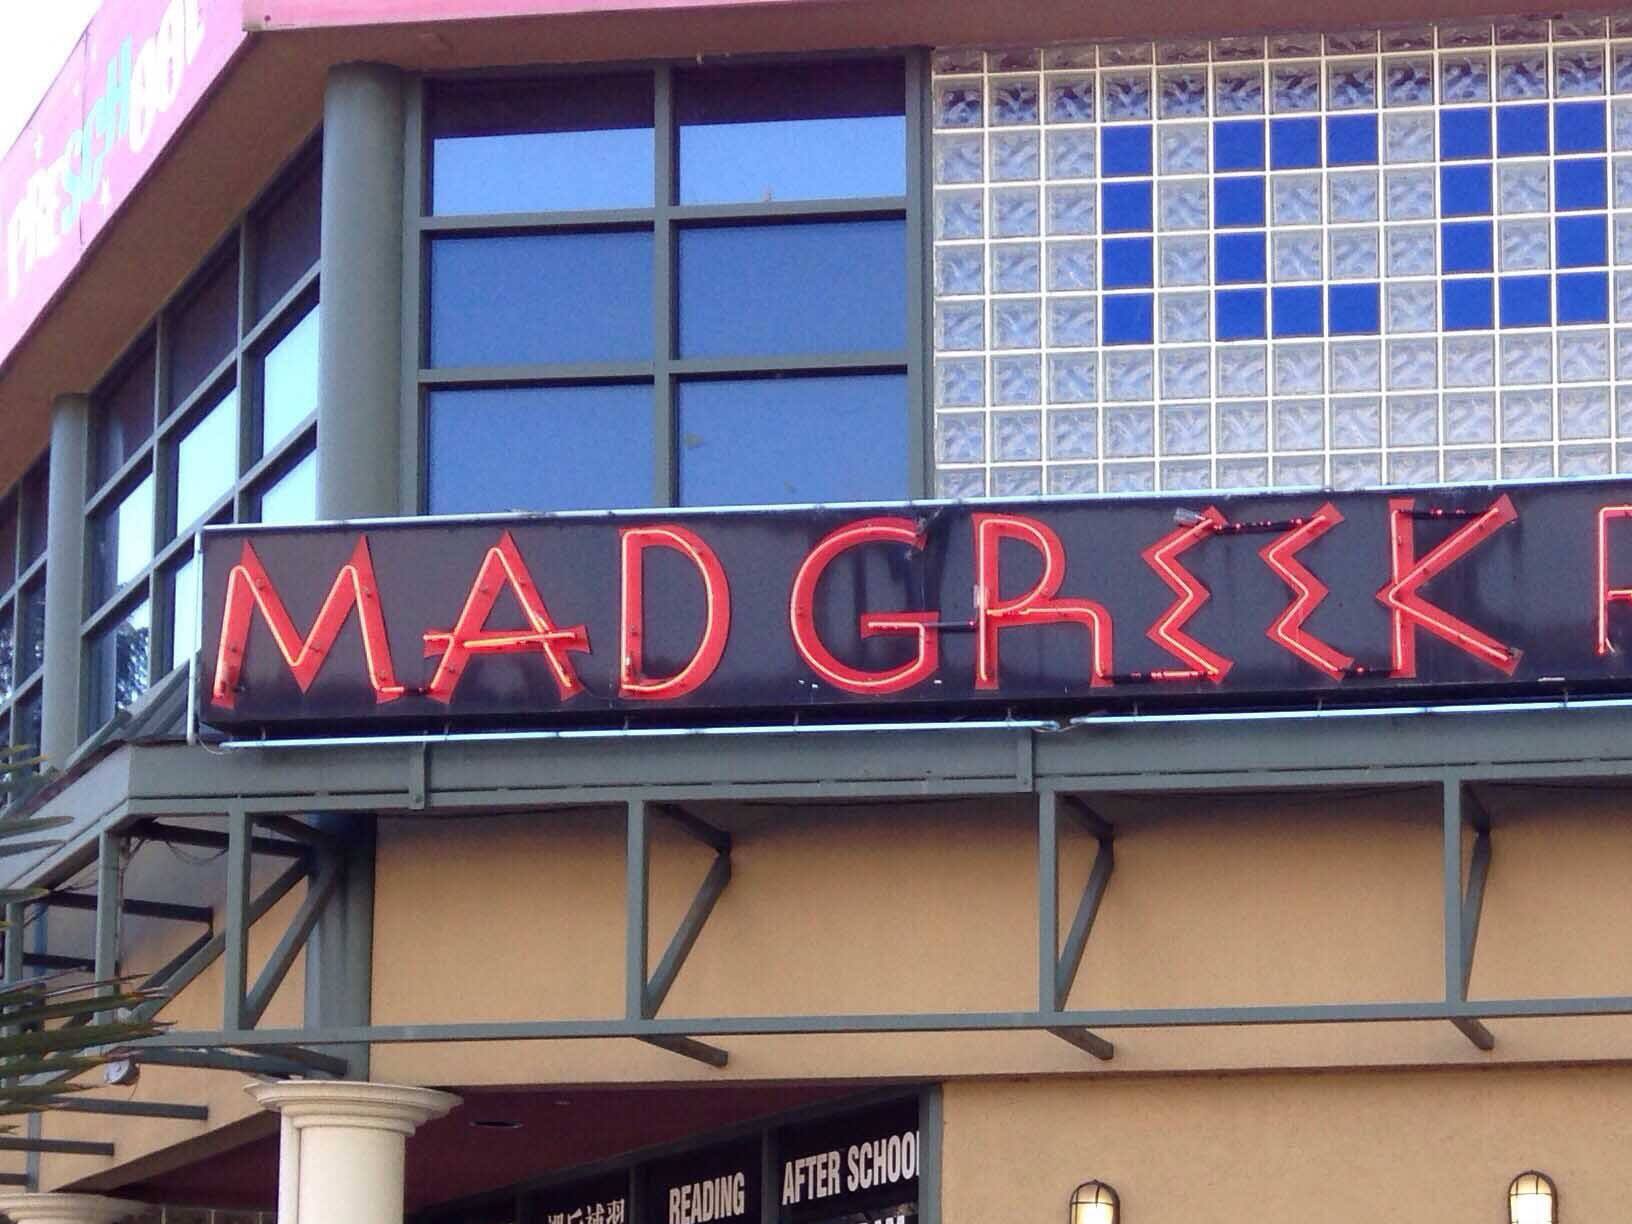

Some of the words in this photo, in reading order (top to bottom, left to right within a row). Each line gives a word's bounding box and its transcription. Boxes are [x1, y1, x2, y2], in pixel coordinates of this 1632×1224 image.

[211, 524, 730, 709] MAD
[790, 493, 1524, 695] GREEK
[782, 1151, 840, 1206] AFTER
